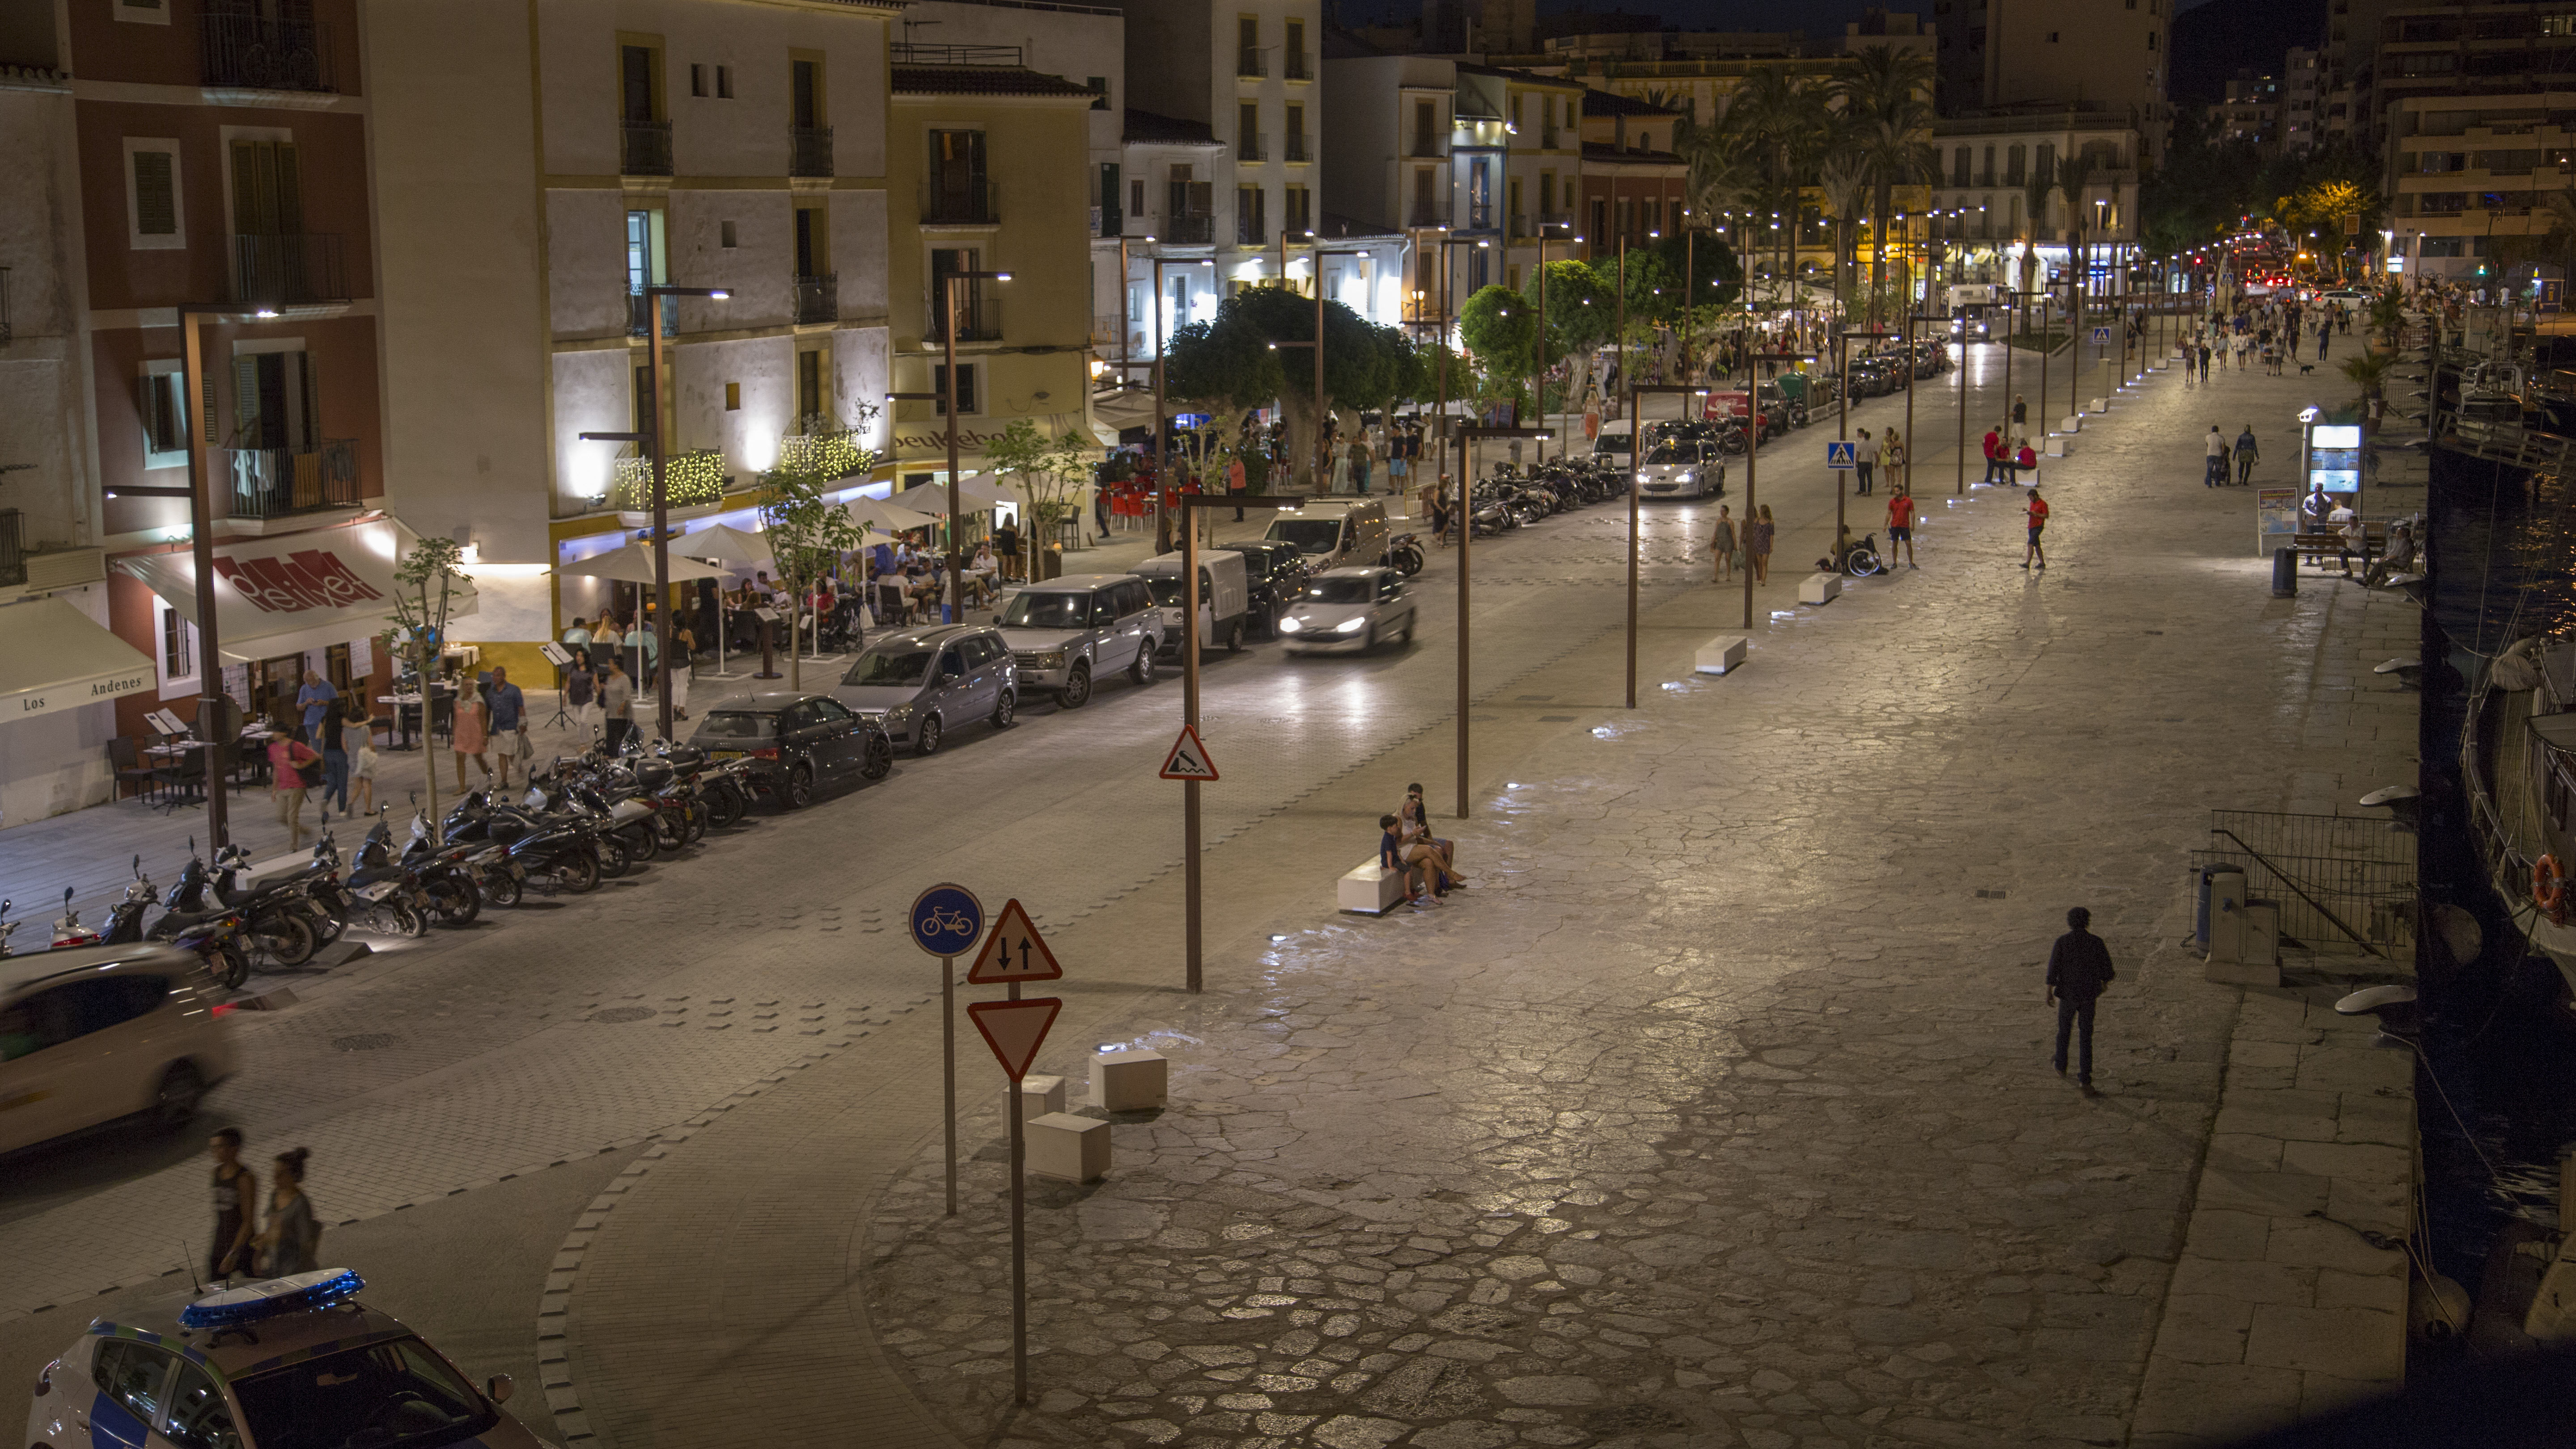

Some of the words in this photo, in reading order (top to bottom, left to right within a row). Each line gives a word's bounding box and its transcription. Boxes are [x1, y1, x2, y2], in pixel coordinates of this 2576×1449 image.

[228, 566, 382, 612] peixet
[23, 697, 45, 712] Los
[91, 677, 142, 696] Andenes
